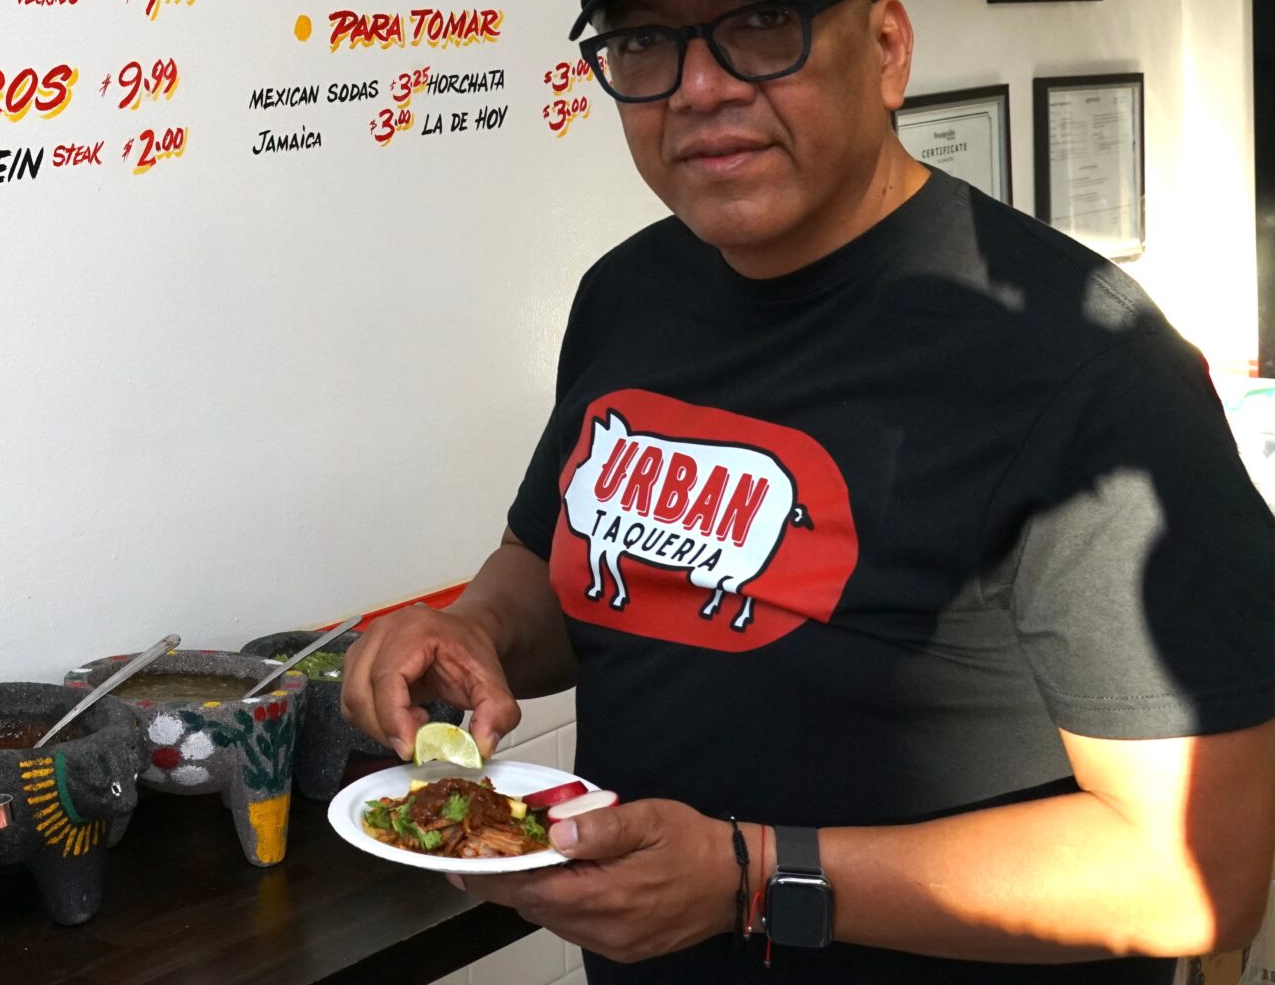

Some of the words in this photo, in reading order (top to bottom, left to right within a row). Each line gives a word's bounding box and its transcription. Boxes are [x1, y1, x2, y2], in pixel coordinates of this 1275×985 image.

[329, 11, 405, 53] PARA
[410, 9, 503, 49] TOMAR
[100, 59, 180, 112] $9.99
[249, 86, 319, 109] MEXICAN
[327, 80, 378, 102] SODAS
[389, 66, 430, 105] $3.25
[428, 70, 504, 95] HORCHATA
[371, 109, 413, 146] $3.00
[422, 114, 442, 135] LA
[451, 113, 468, 132] DE
[475, 105, 508, 129] HOY
[543, 97, 590, 135] $3.00
[123, 128, 187, 170] $2.00
[921, 142, 967, 159] CERTIFICATE
[594, 438, 768, 547] URBAN
[591, 510, 723, 572] TAQUERIA
